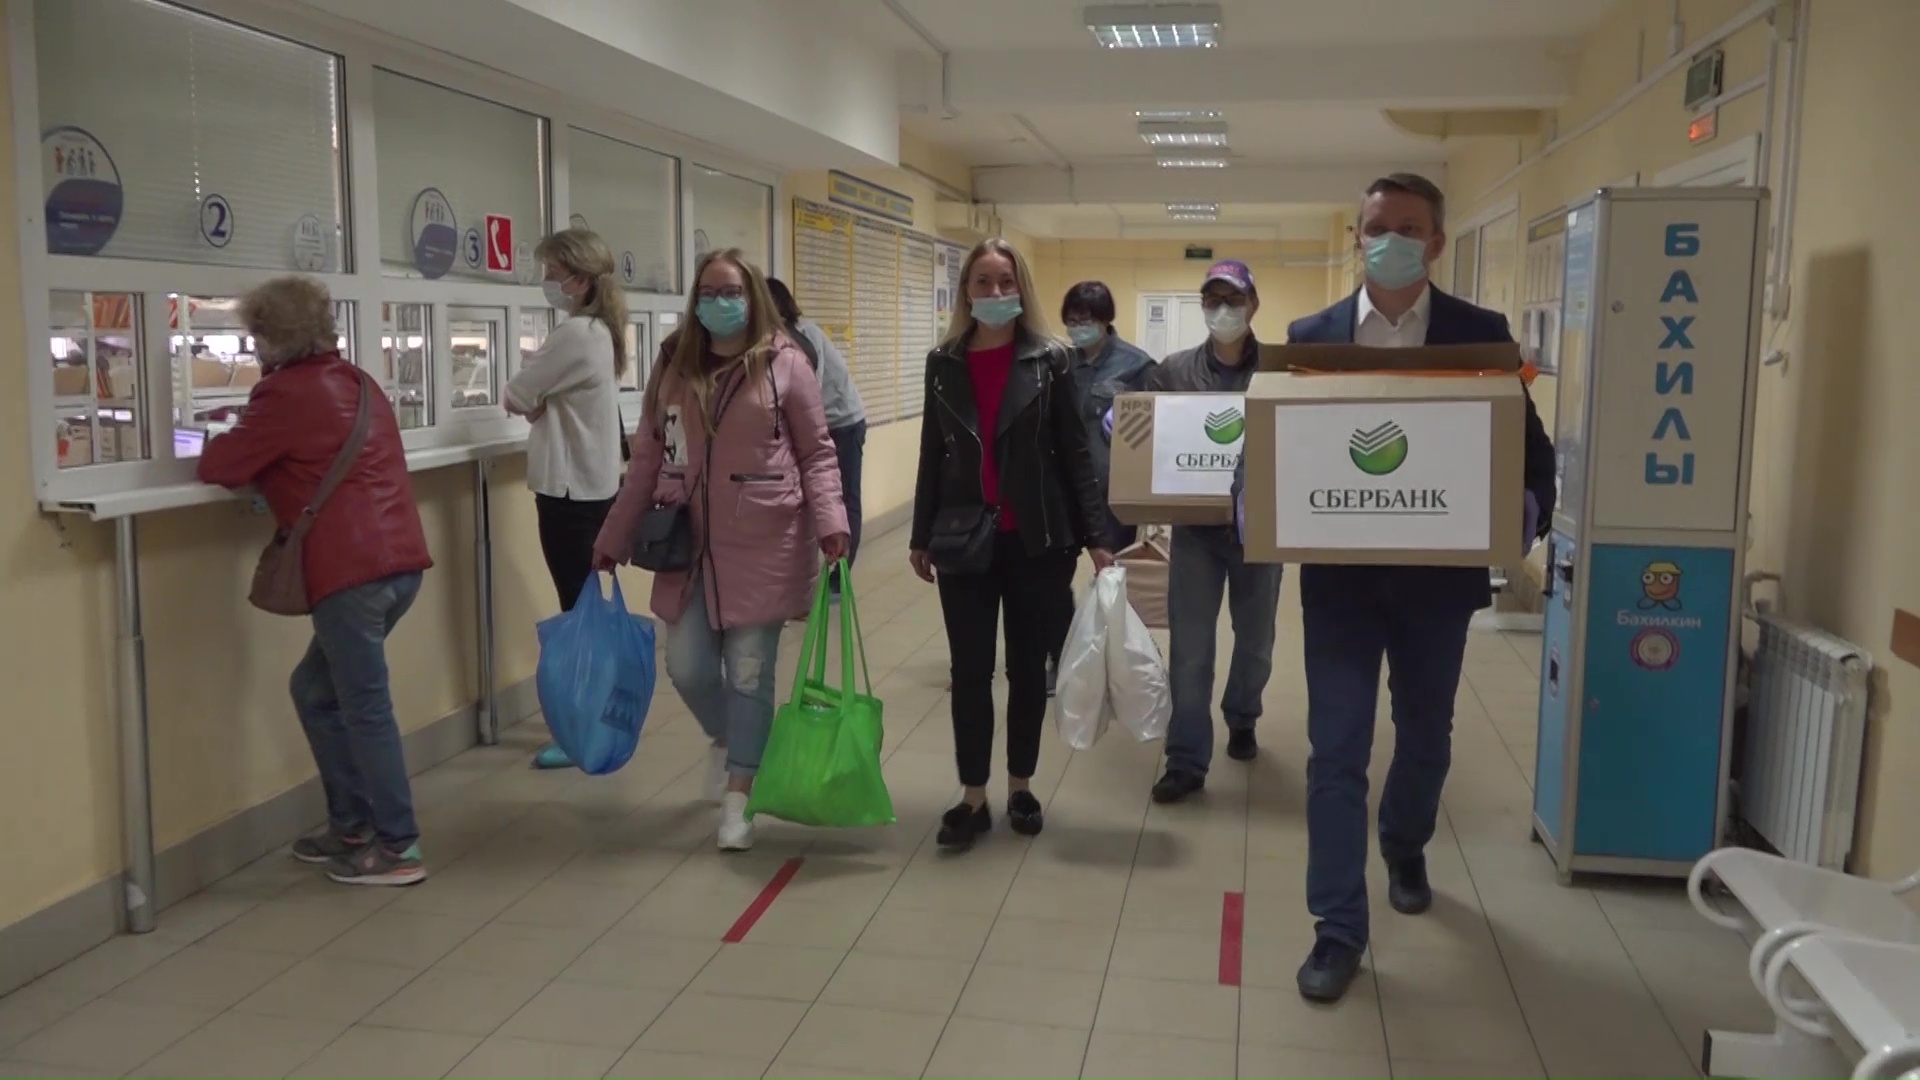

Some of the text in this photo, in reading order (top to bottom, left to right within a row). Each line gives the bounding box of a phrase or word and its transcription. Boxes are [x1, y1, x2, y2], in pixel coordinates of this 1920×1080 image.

[208, 202, 226, 237] 2
[468, 235, 479, 262] 3
[624, 255, 632, 278] 4
[1645, 223, 1700, 485] БАХИЛЫ
[1309, 488, 1448, 508] СБЕРБАНК
[1616, 610, 1702, 628] Бахилкин
